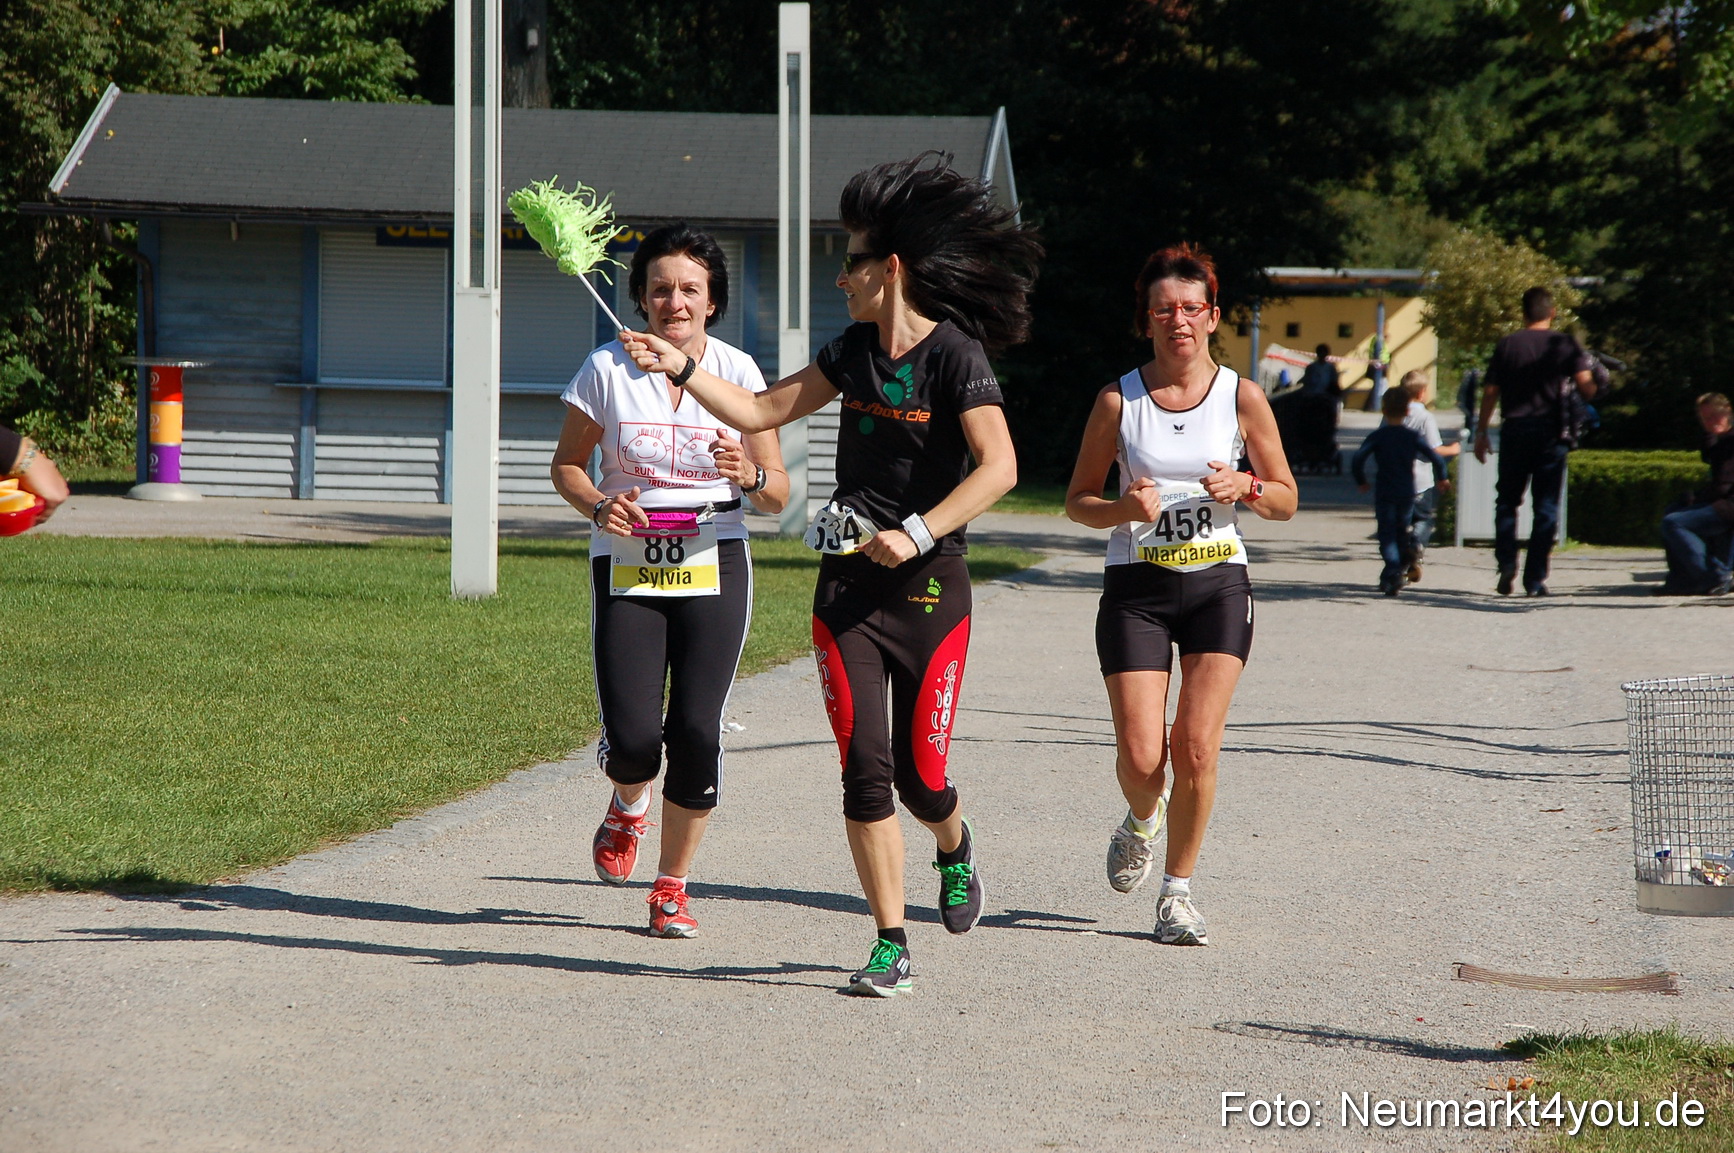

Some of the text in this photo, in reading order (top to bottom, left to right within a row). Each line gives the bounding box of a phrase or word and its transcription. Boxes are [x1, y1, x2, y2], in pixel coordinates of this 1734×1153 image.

[843, 395, 931, 422] Laufbox.de
[634, 466, 656, 476] RUN
[677, 469, 699, 478] NOT
[1155, 506, 1214, 543] 458
[644, 536, 685, 565] 88
[1143, 541, 1232, 565] Margareta
[638, 566, 692, 588] Sylvia
